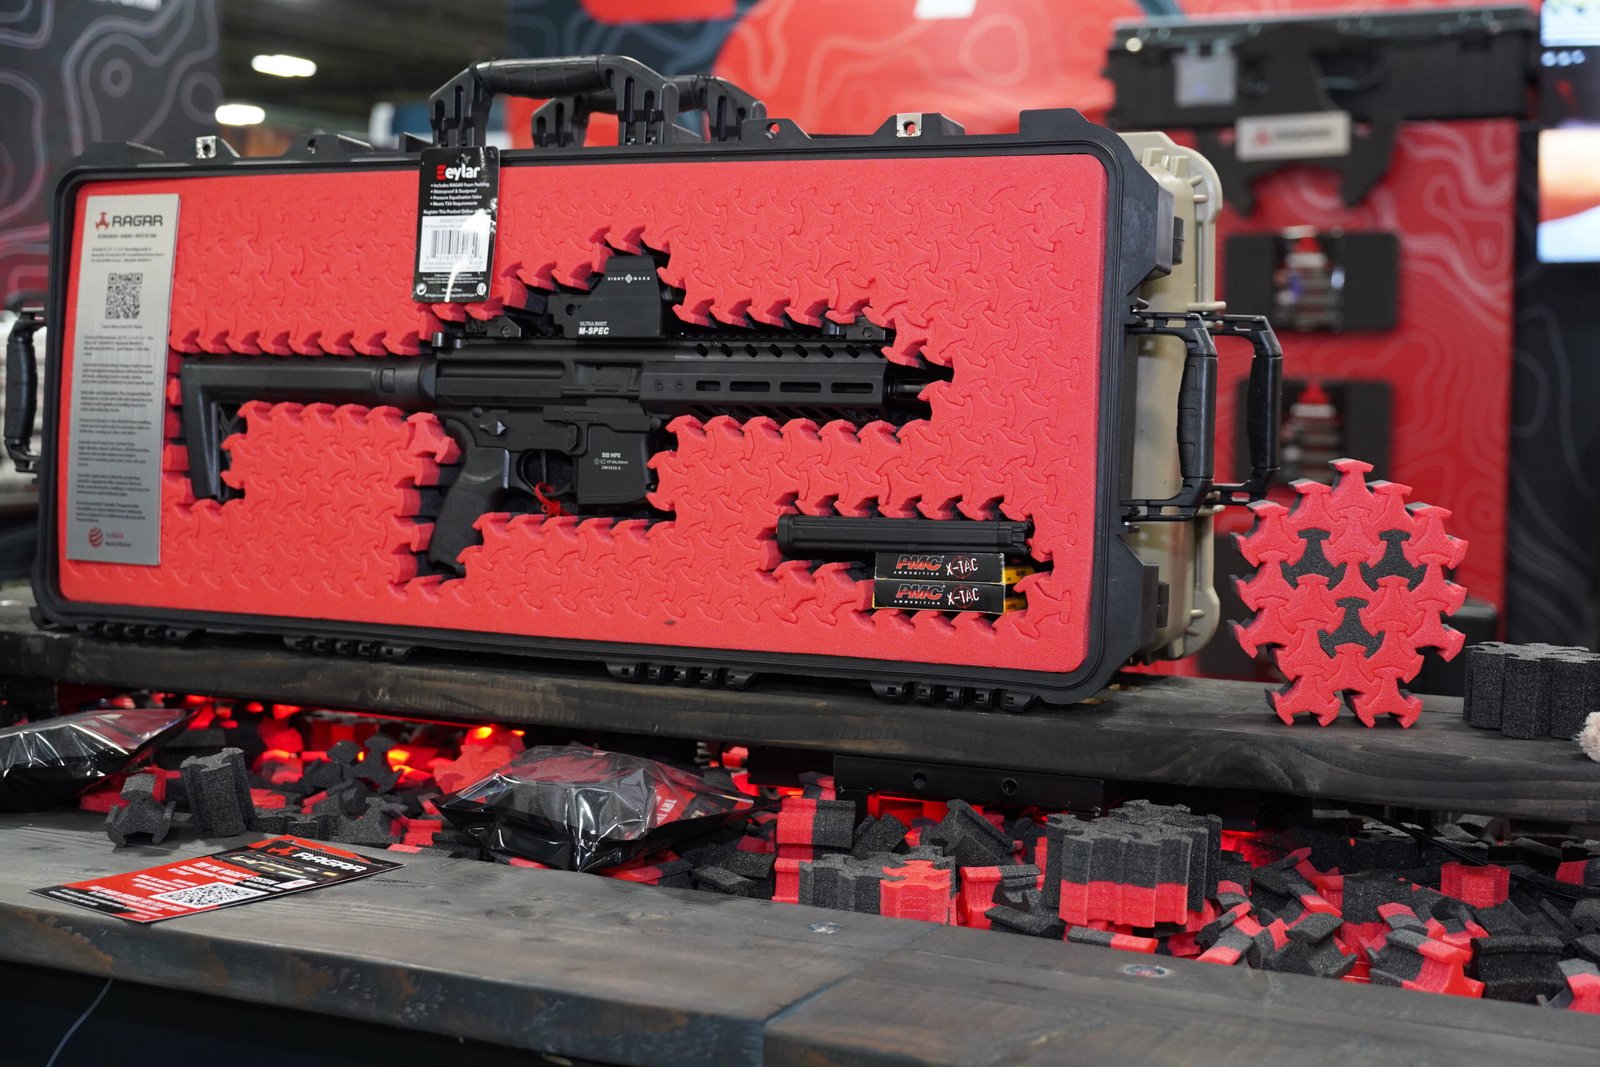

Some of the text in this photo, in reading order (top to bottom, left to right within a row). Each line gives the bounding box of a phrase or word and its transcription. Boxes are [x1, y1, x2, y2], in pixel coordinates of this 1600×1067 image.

[112, 215, 163, 227] RAGAR
[578, 327, 610, 335] M-SPEC
[895, 554, 978, 576] PMC X-TAC
[895, 584, 980, 605] PMC X-TAC
[291, 851, 367, 873] RAGAR
